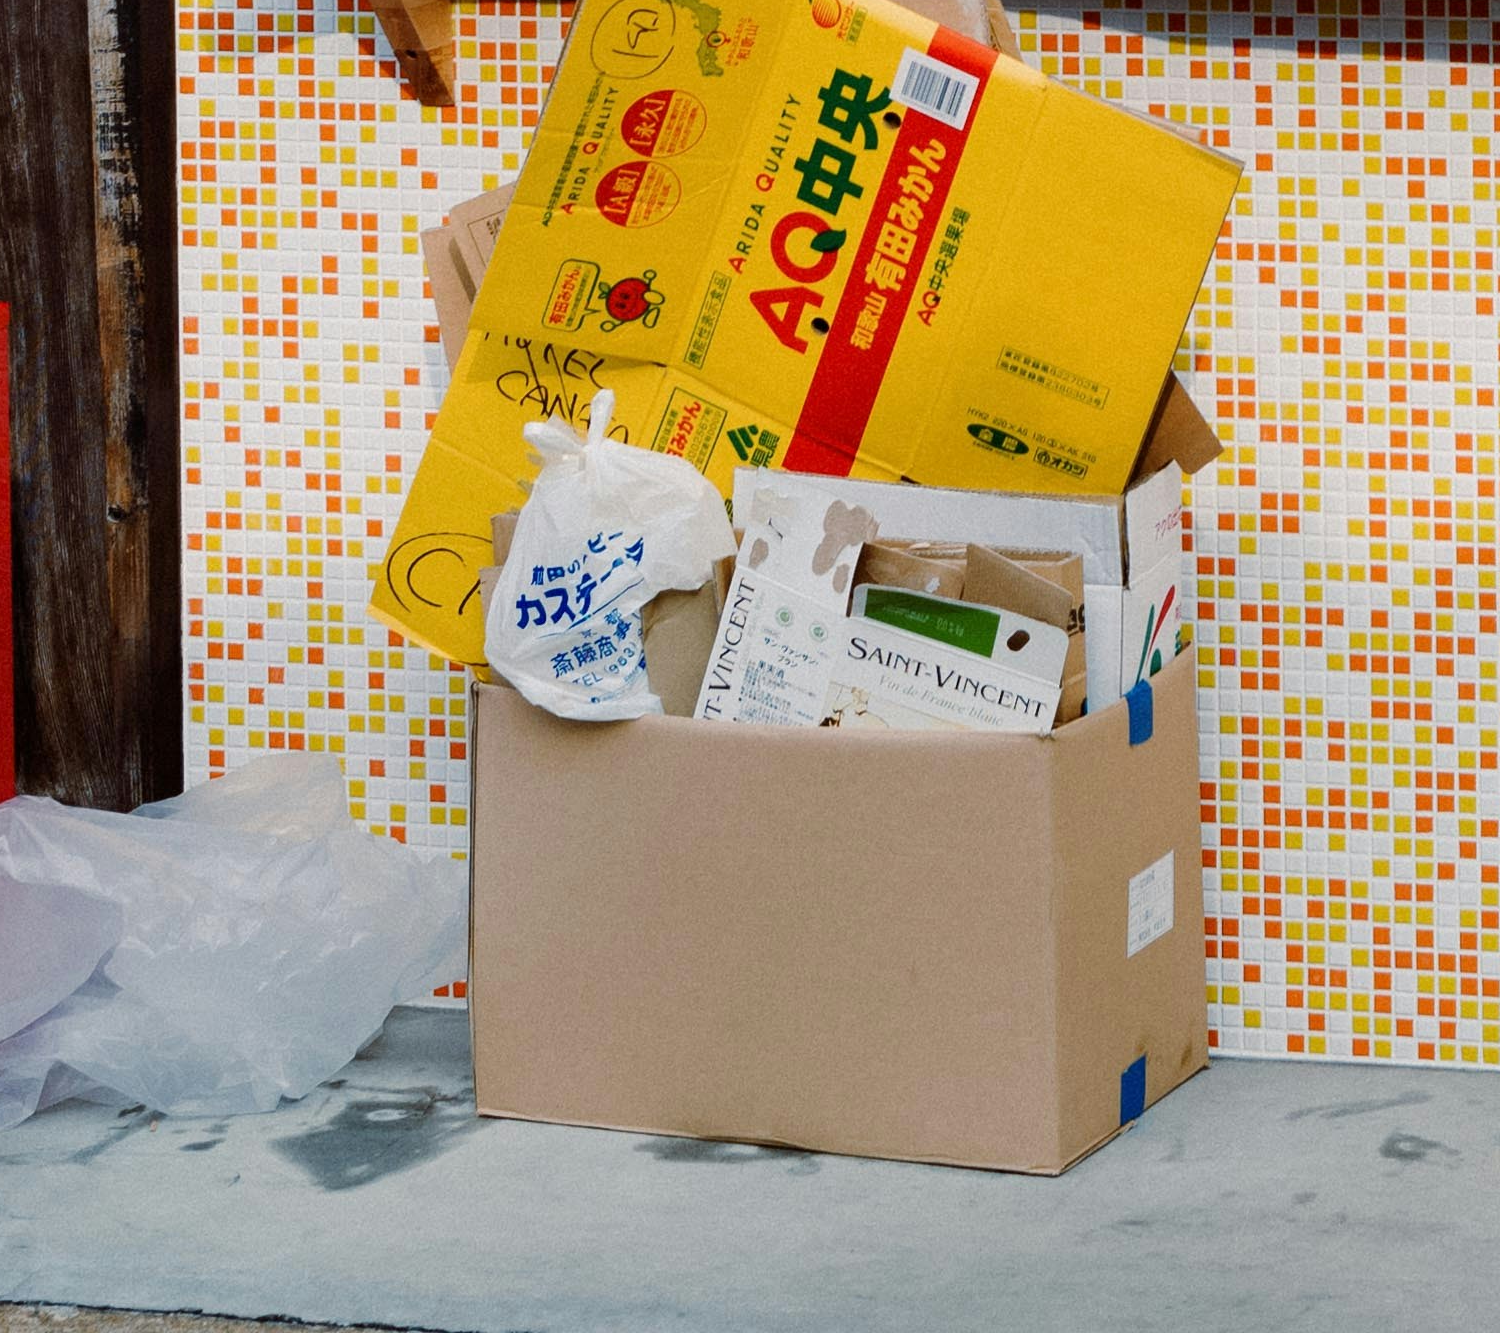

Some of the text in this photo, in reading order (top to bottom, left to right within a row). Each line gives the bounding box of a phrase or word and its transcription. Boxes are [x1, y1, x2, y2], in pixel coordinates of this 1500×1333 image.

[560, 162, 589, 215] ARIDA
[583, 85, 620, 155] QUALITY
[729, 92, 804, 274] ARIDA QUALITY
[850, 137, 949, 351] 和歌山 有田みかん
[847, 637, 1048, 719] SAINT-VINCENT
